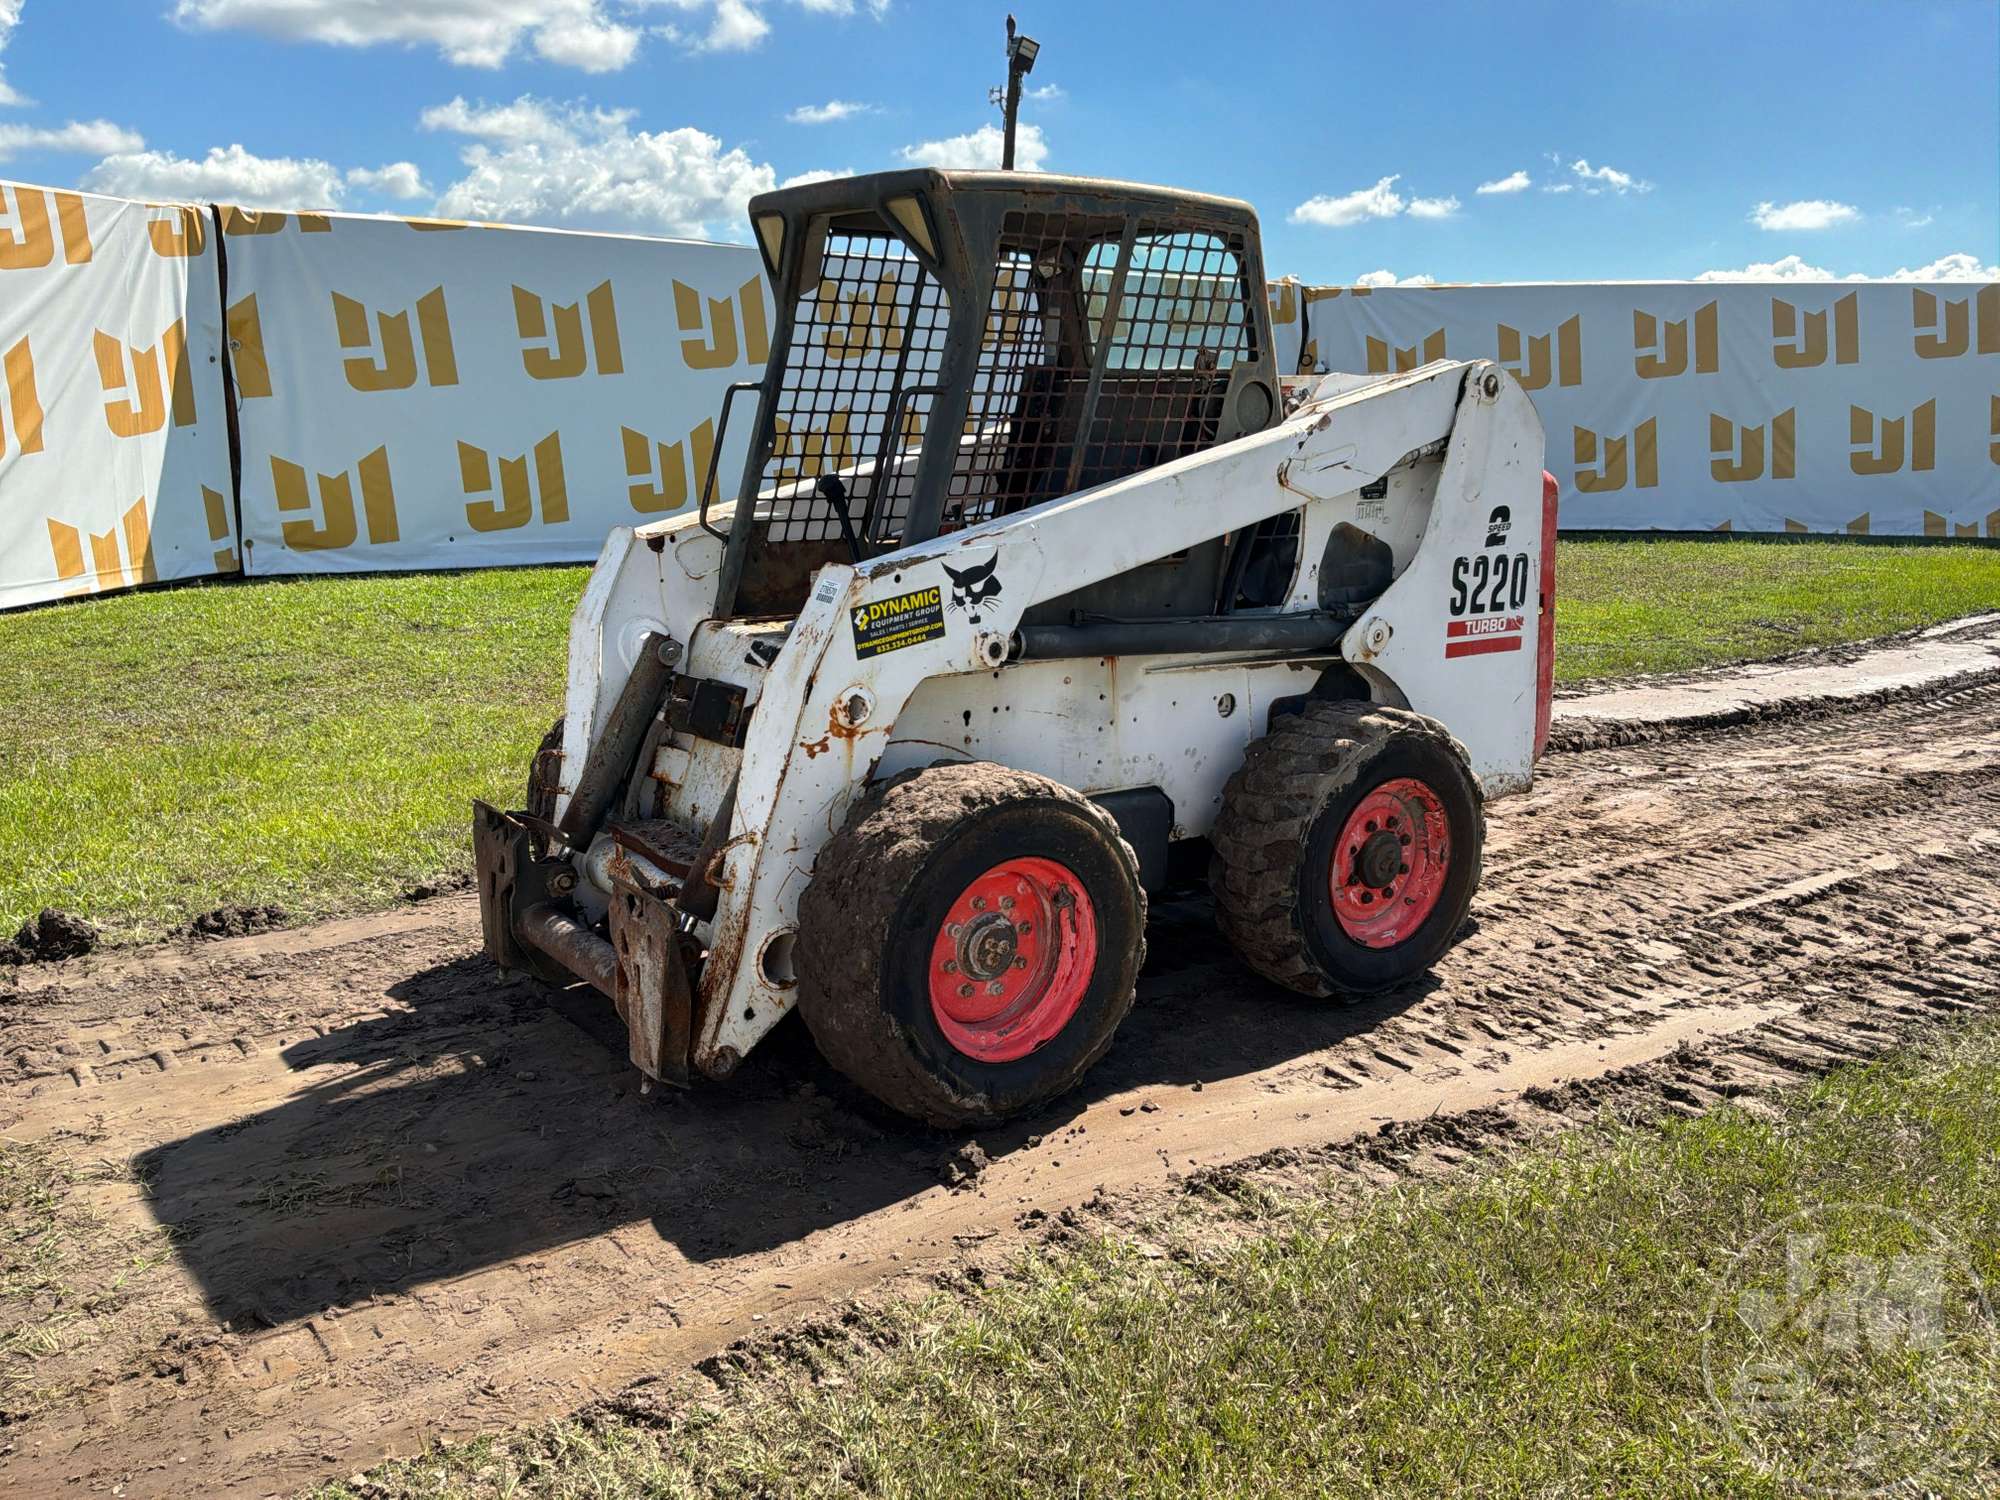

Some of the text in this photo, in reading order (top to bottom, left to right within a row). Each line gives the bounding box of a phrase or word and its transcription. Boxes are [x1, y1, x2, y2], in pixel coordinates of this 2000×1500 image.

[1487, 522, 1512, 534] SPEED
[1450, 552, 1529, 617] S220
[869, 589, 940, 620] DYNAMIC
[871, 604, 940, 629] EQUIPMENT GROUP
[1465, 617, 1507, 635] TURBO
